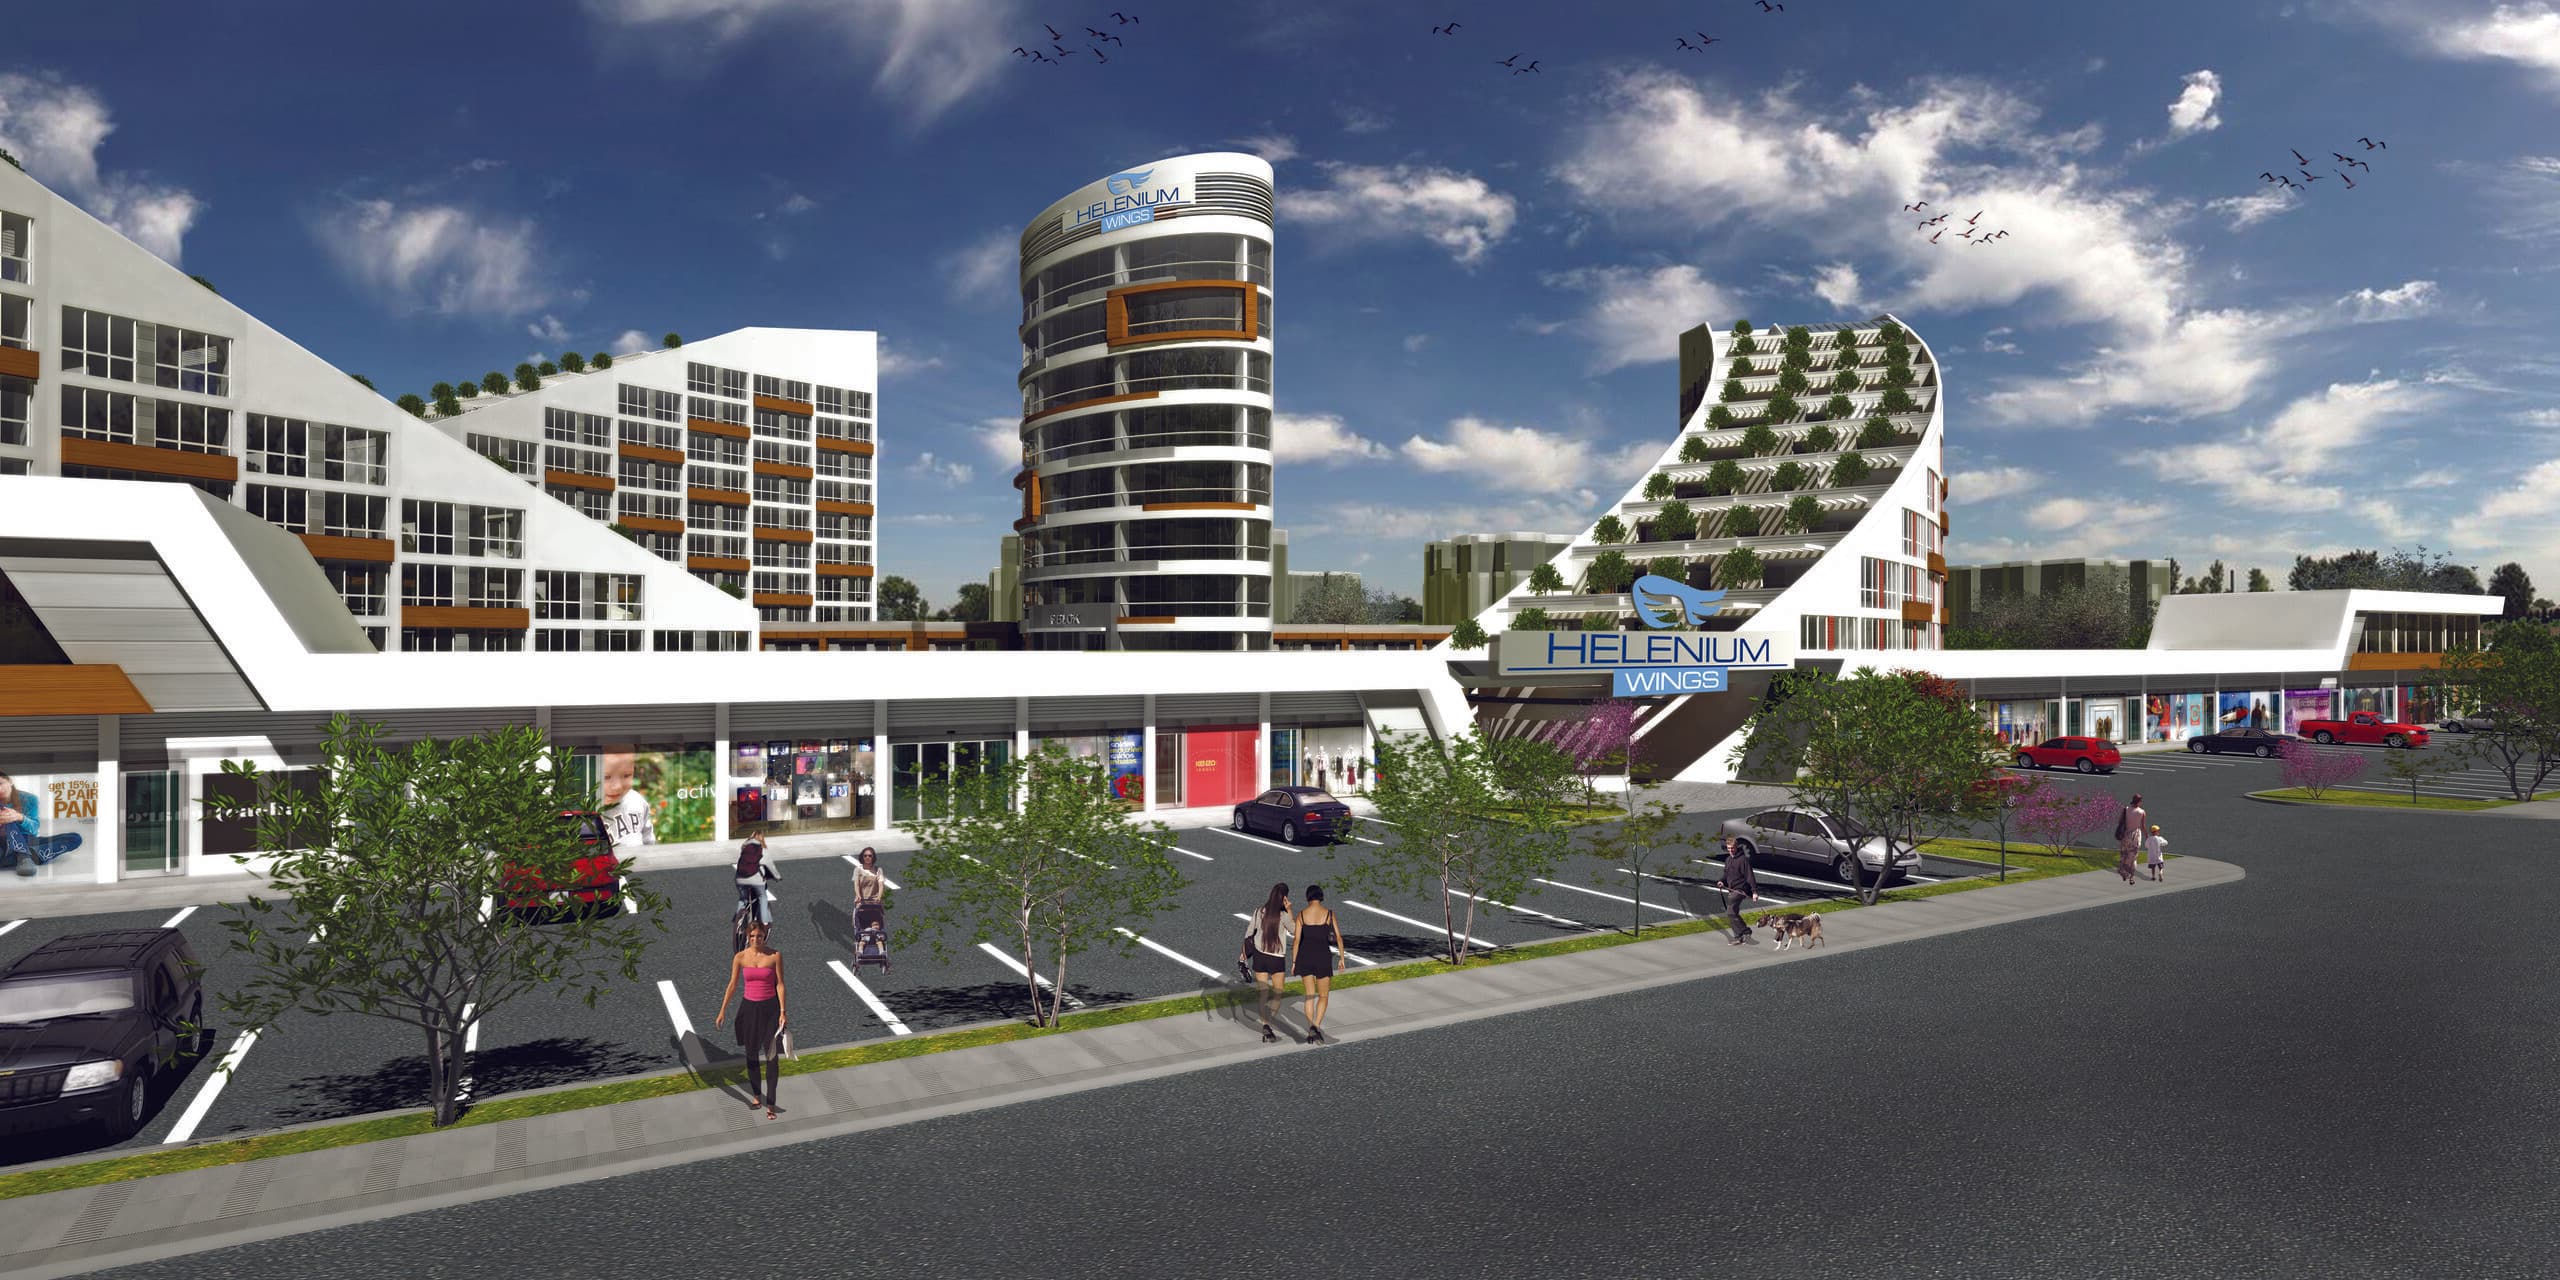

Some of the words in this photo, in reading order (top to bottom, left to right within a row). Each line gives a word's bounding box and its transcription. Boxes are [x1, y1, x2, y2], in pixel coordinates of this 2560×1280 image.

[1077, 187, 1180, 224] HELENIUM
[1106, 209, 1150, 231] WINGS
[1547, 632, 1770, 664] HELENIUM
[1625, 670, 1720, 692] WINGS
[49, 781, 65, 792] get
[67, 780, 90, 789] 15%
[54, 790, 63, 801] 2
[53, 800, 97, 819] PAN
